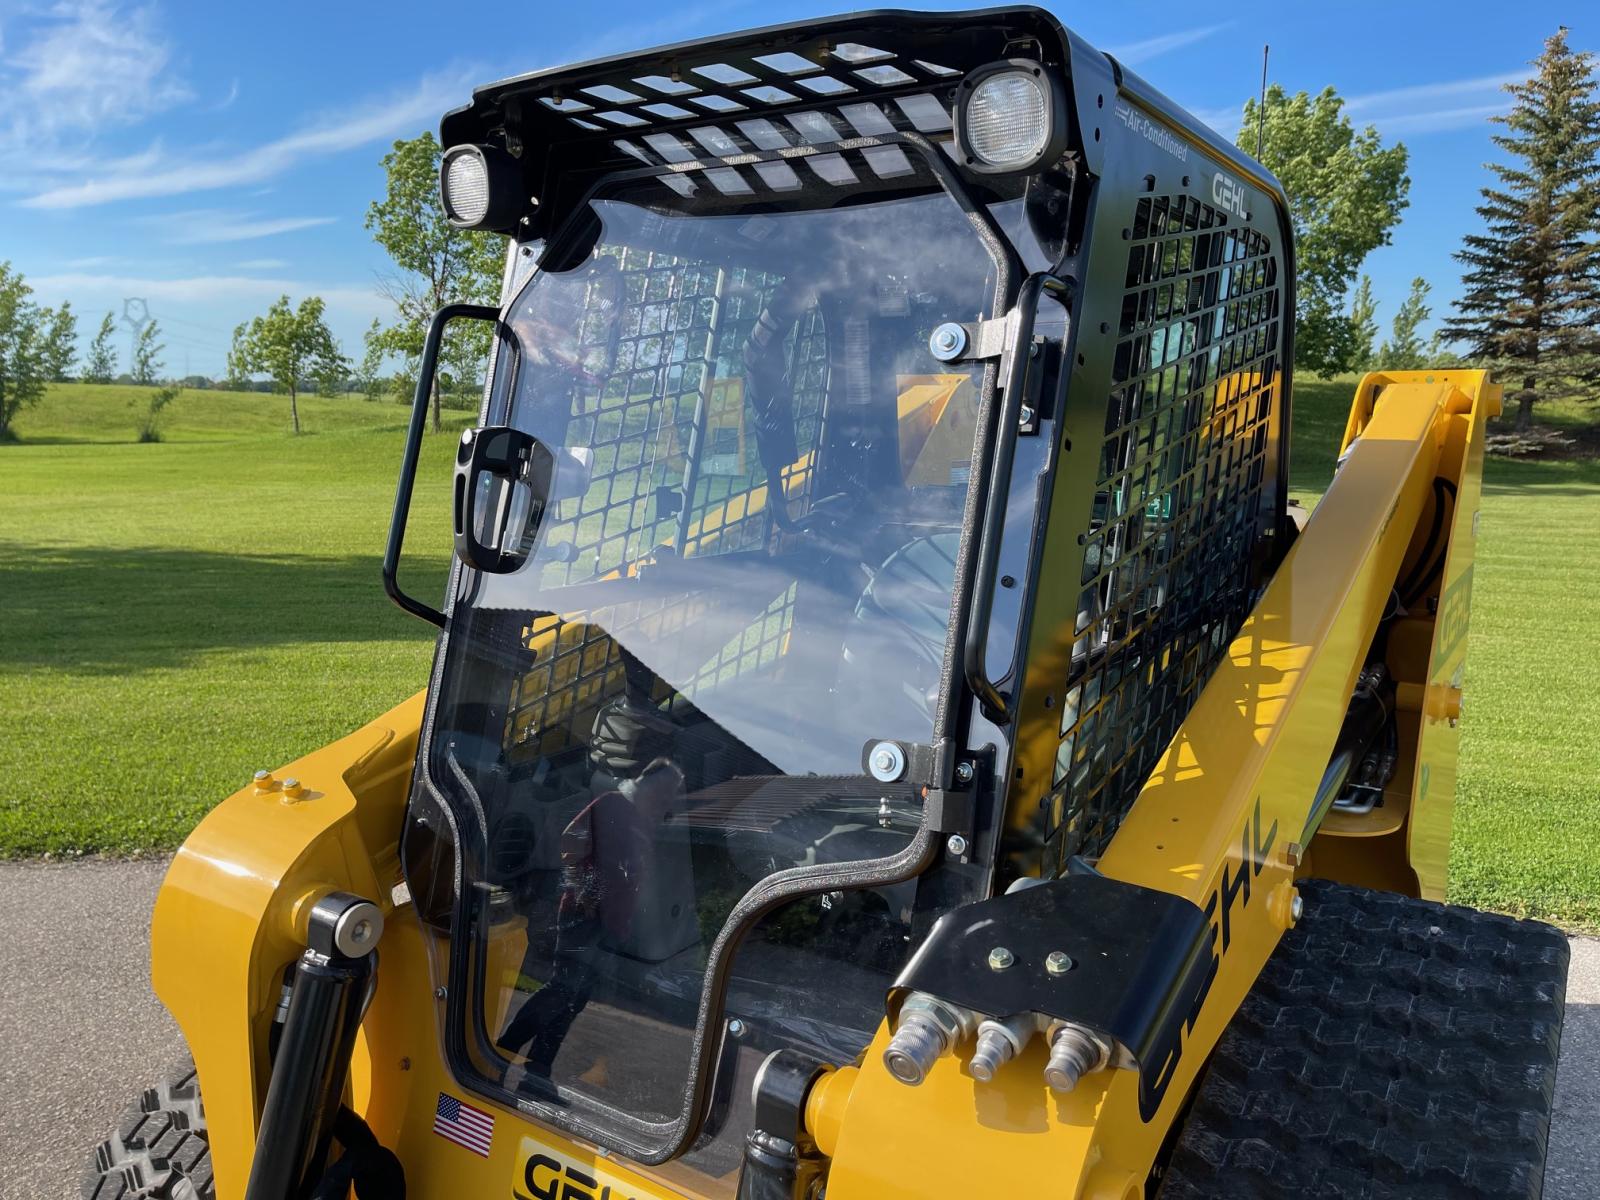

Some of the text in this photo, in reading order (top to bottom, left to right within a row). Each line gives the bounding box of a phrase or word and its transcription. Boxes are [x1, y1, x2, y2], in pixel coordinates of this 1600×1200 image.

[1128, 110, 1188, 162] Air-Conditioned
[1212, 172, 1247, 220] GEHL
[525, 1153, 636, 1200] GE
